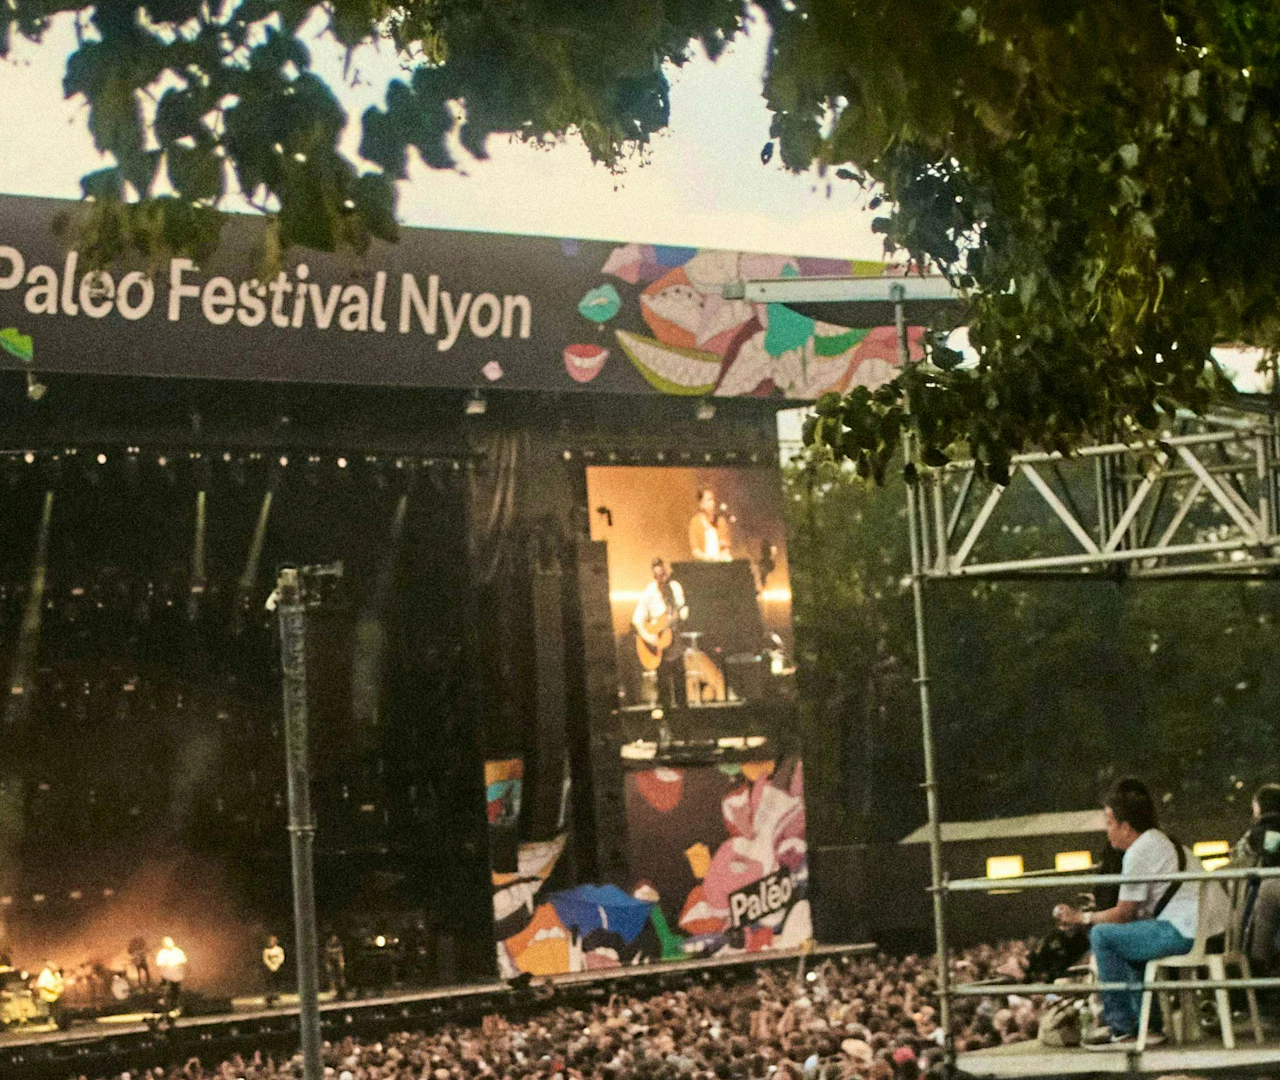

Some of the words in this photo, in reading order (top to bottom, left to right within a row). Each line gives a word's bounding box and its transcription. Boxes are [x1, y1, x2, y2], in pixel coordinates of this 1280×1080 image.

[168, 258, 386, 332] Festival
[399, 273, 531, 351] Nyon
[730, 876, 792, 928] Paléo
